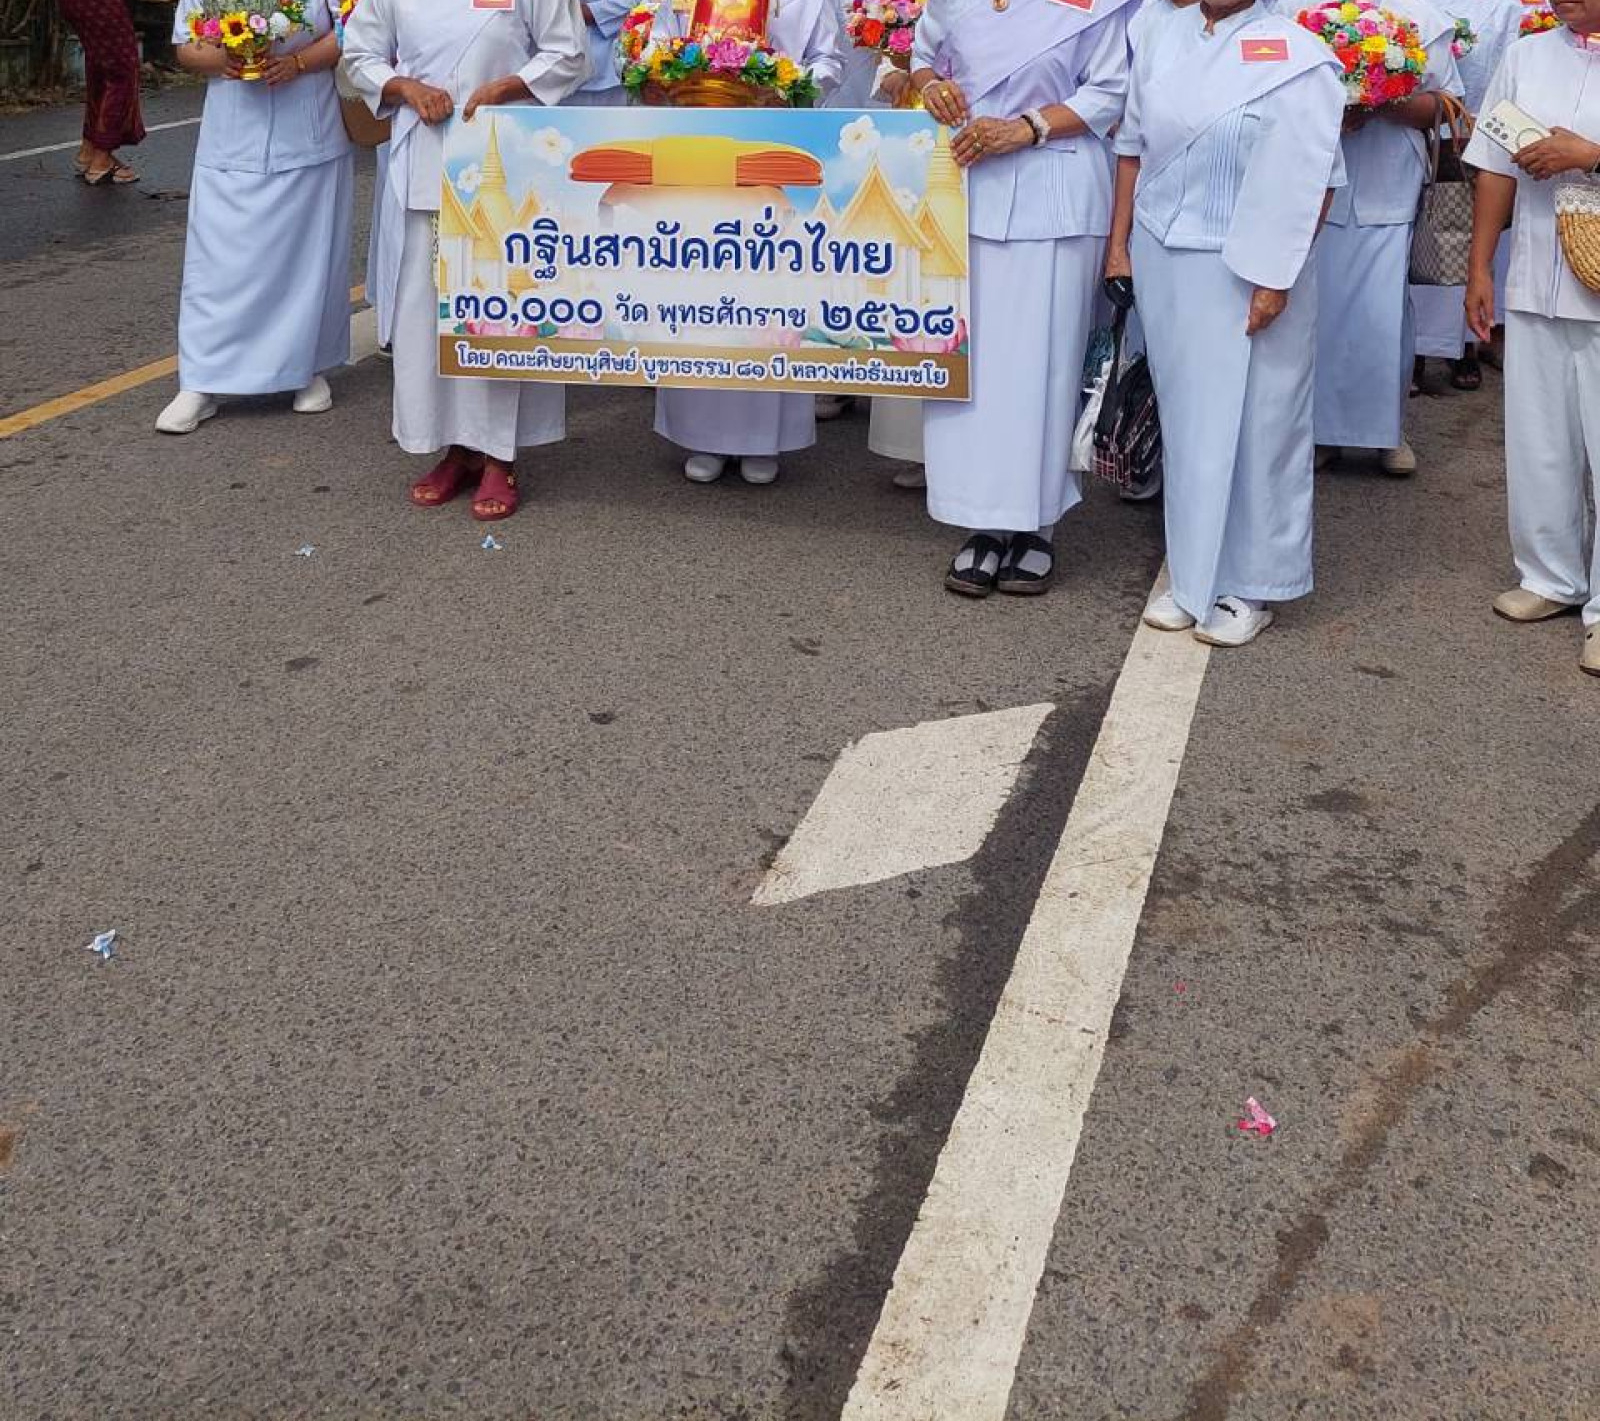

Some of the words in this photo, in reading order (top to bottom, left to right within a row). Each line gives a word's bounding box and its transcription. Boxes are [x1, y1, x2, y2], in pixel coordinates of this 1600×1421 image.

[504, 205, 894, 281] กฐินสามัคคีทั่วไทย
[454, 293, 603, 327] ๓๐,๐๐๐
[615, 293, 648, 323] วัด
[657, 296, 806, 334] พุทธศักราช
[821, 299, 954, 336] ๒๕๖๘
[458, 343, 491, 365] โดย
[496, 347, 636, 377] คณะศิษยานุศิษย์
[642, 360, 731, 380] บูชาธรรม
[736, 362, 766, 378] ๘๑
[771, 357, 785, 377] ปี
